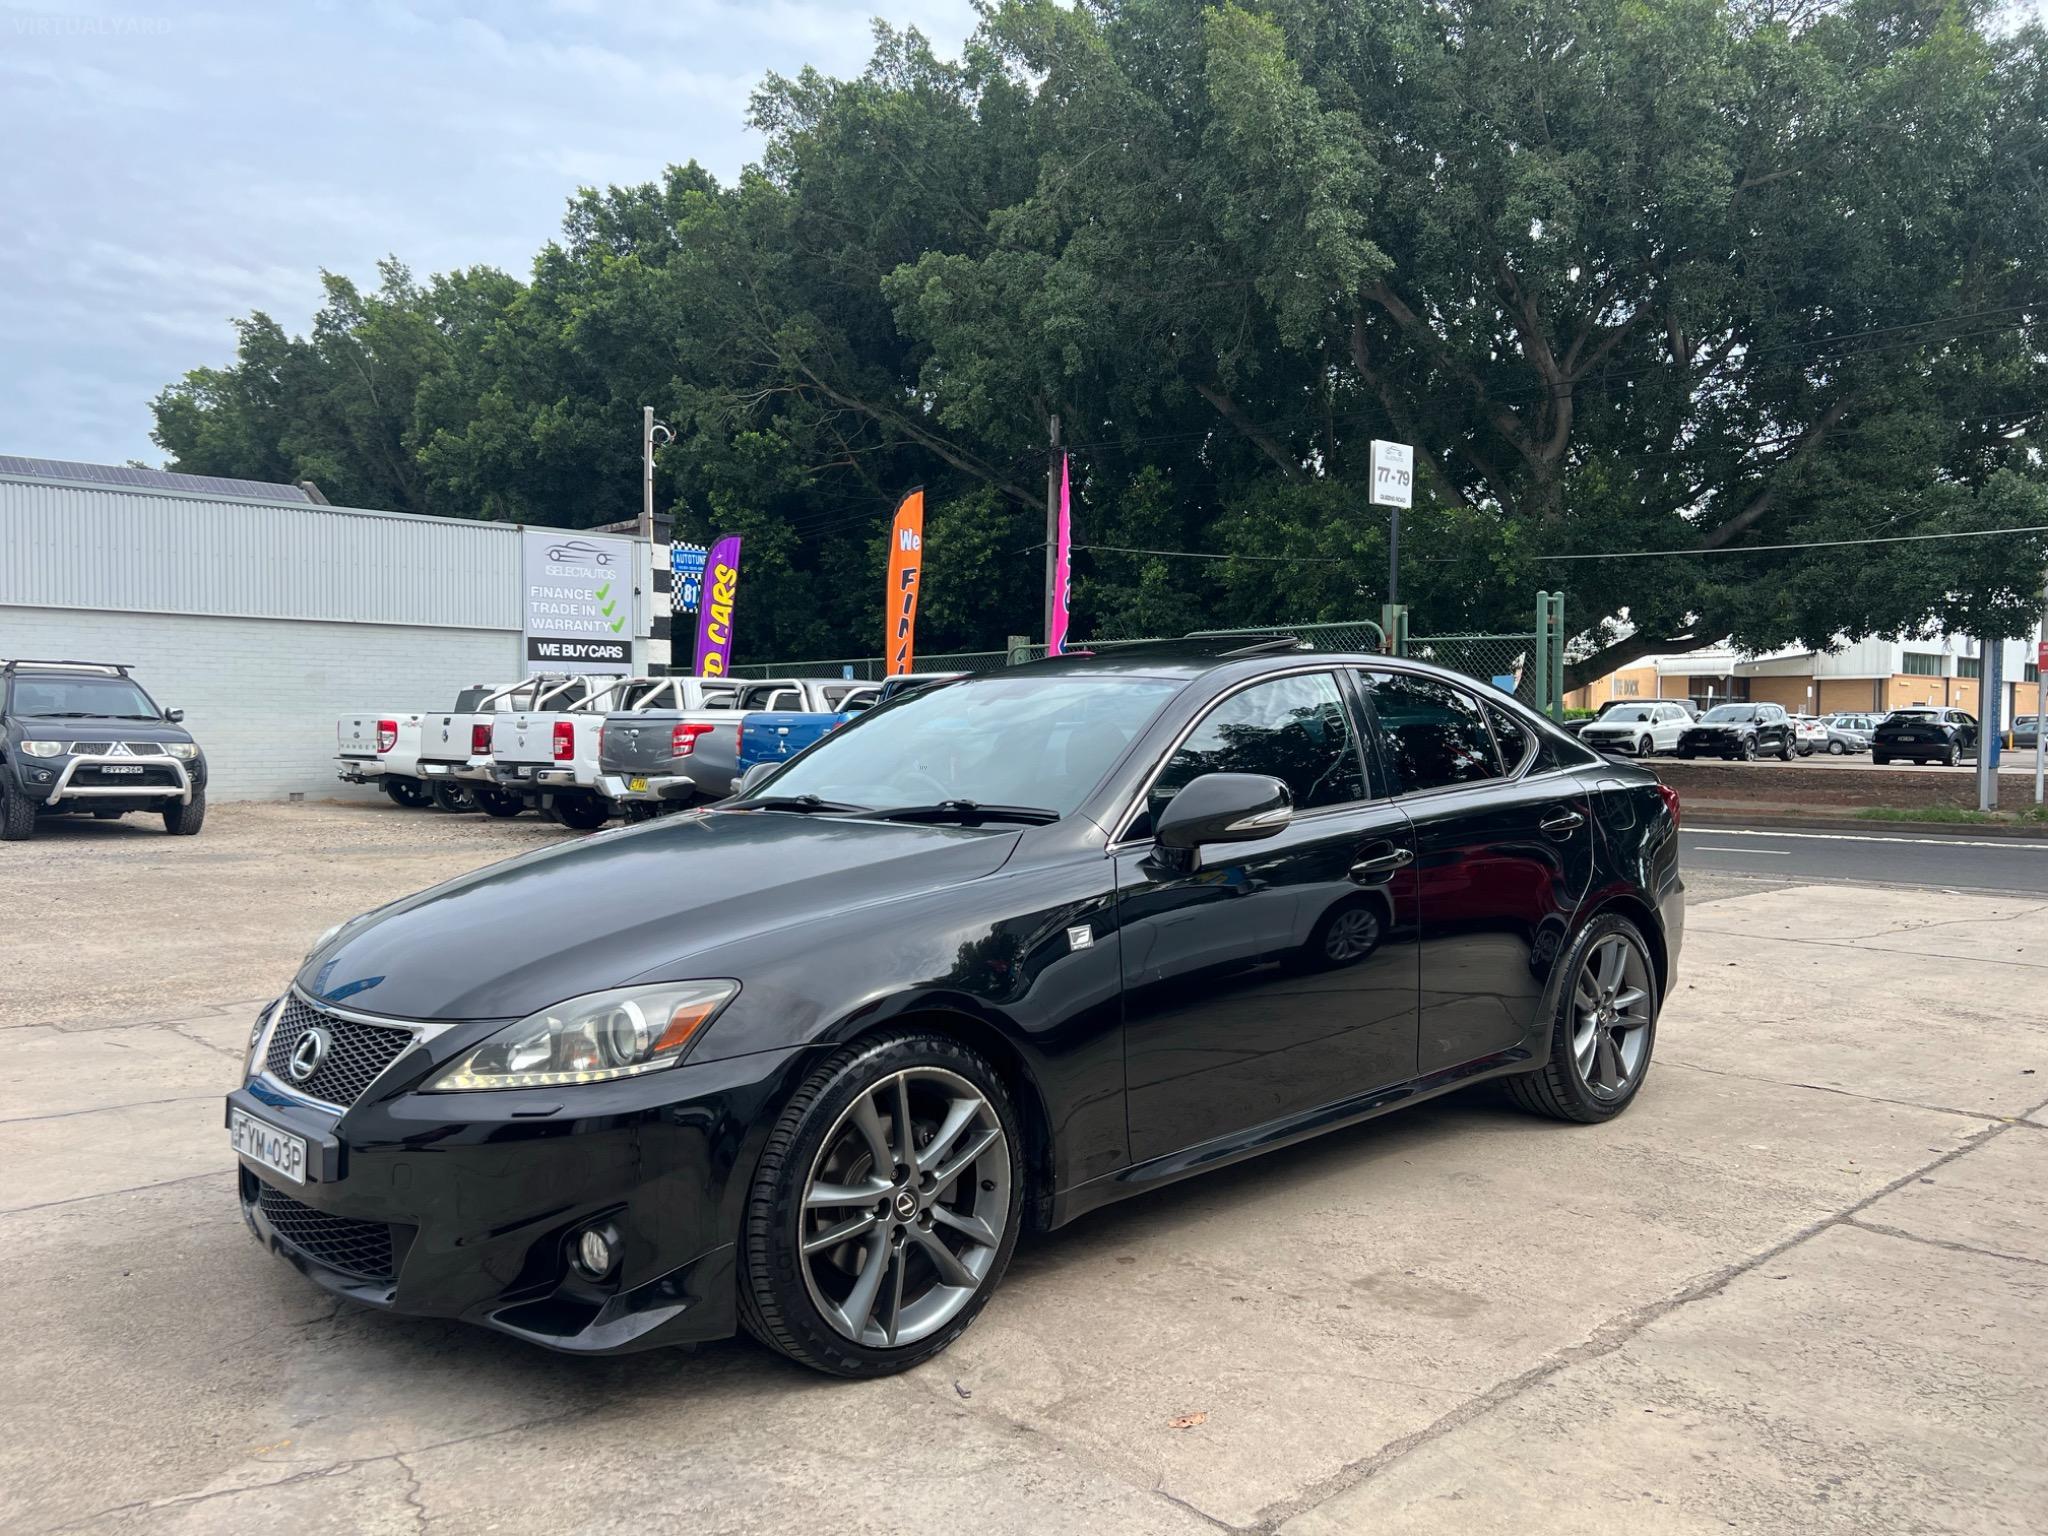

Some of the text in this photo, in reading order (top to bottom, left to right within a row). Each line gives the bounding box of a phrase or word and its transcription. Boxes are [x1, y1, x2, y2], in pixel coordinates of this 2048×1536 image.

[900, 528, 921, 551] We
[530, 586, 593, 601] FINANCE
[683, 583, 698, 604] 81
[530, 602, 596, 617] TRADE IN
[707, 563, 737, 645] CARS
[531, 618, 611, 632] WARRANTY
[537, 643, 623, 659] WE BUY CARS
